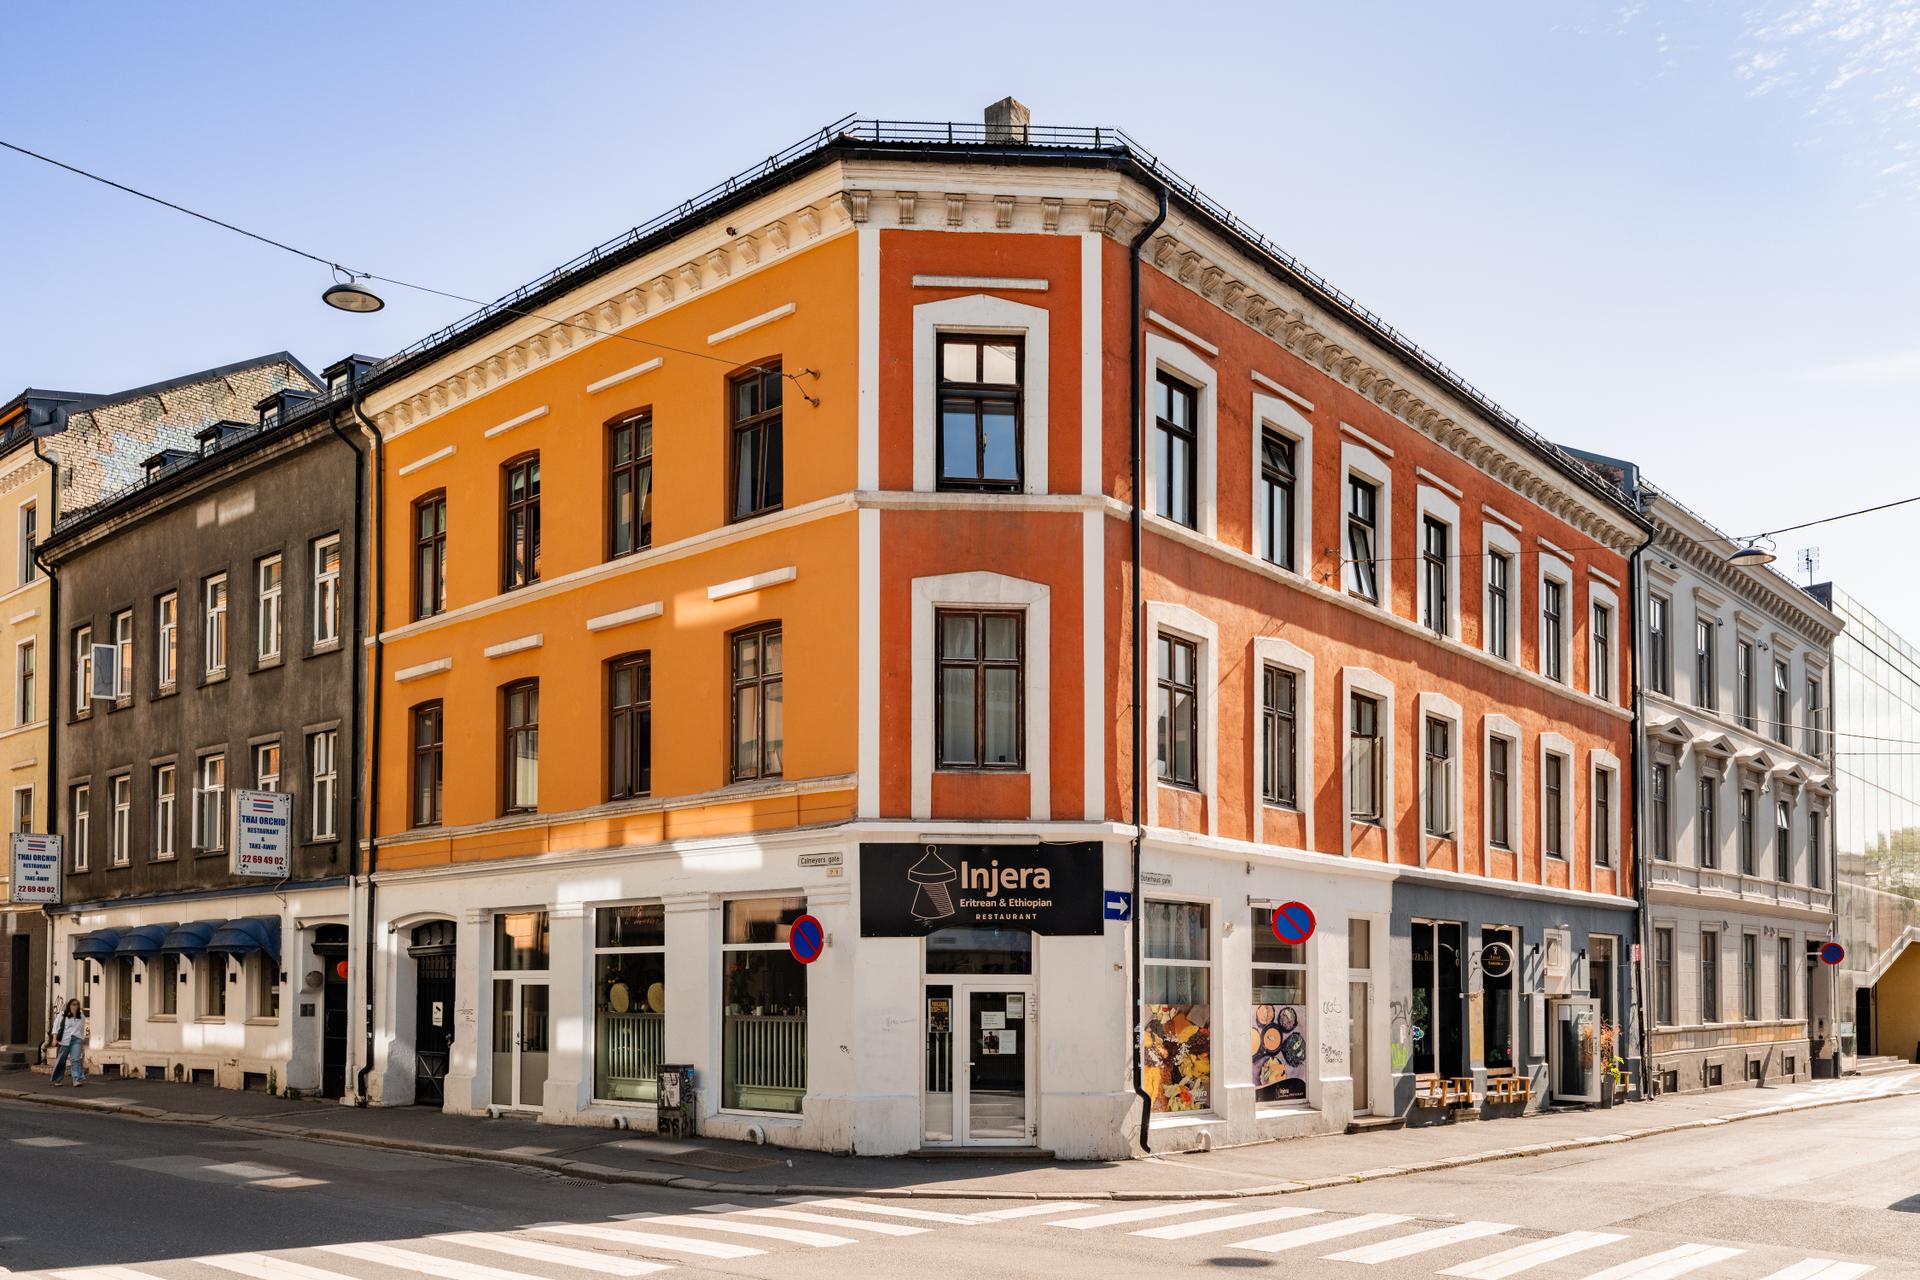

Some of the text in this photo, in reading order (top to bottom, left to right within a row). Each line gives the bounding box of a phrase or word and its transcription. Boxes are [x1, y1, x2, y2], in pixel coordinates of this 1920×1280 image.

[242, 815, 286, 826] THAI ORCHID
[247, 827, 279, 835] RESTAURANT
[33, 854, 57, 862] ORCHID
[242, 855, 284, 865] 22 69 49 02
[961, 859, 1050, 897] Injera
[27, 885, 36, 893] 69
[960, 898, 1052, 909] Eritrean & Ethiopian
